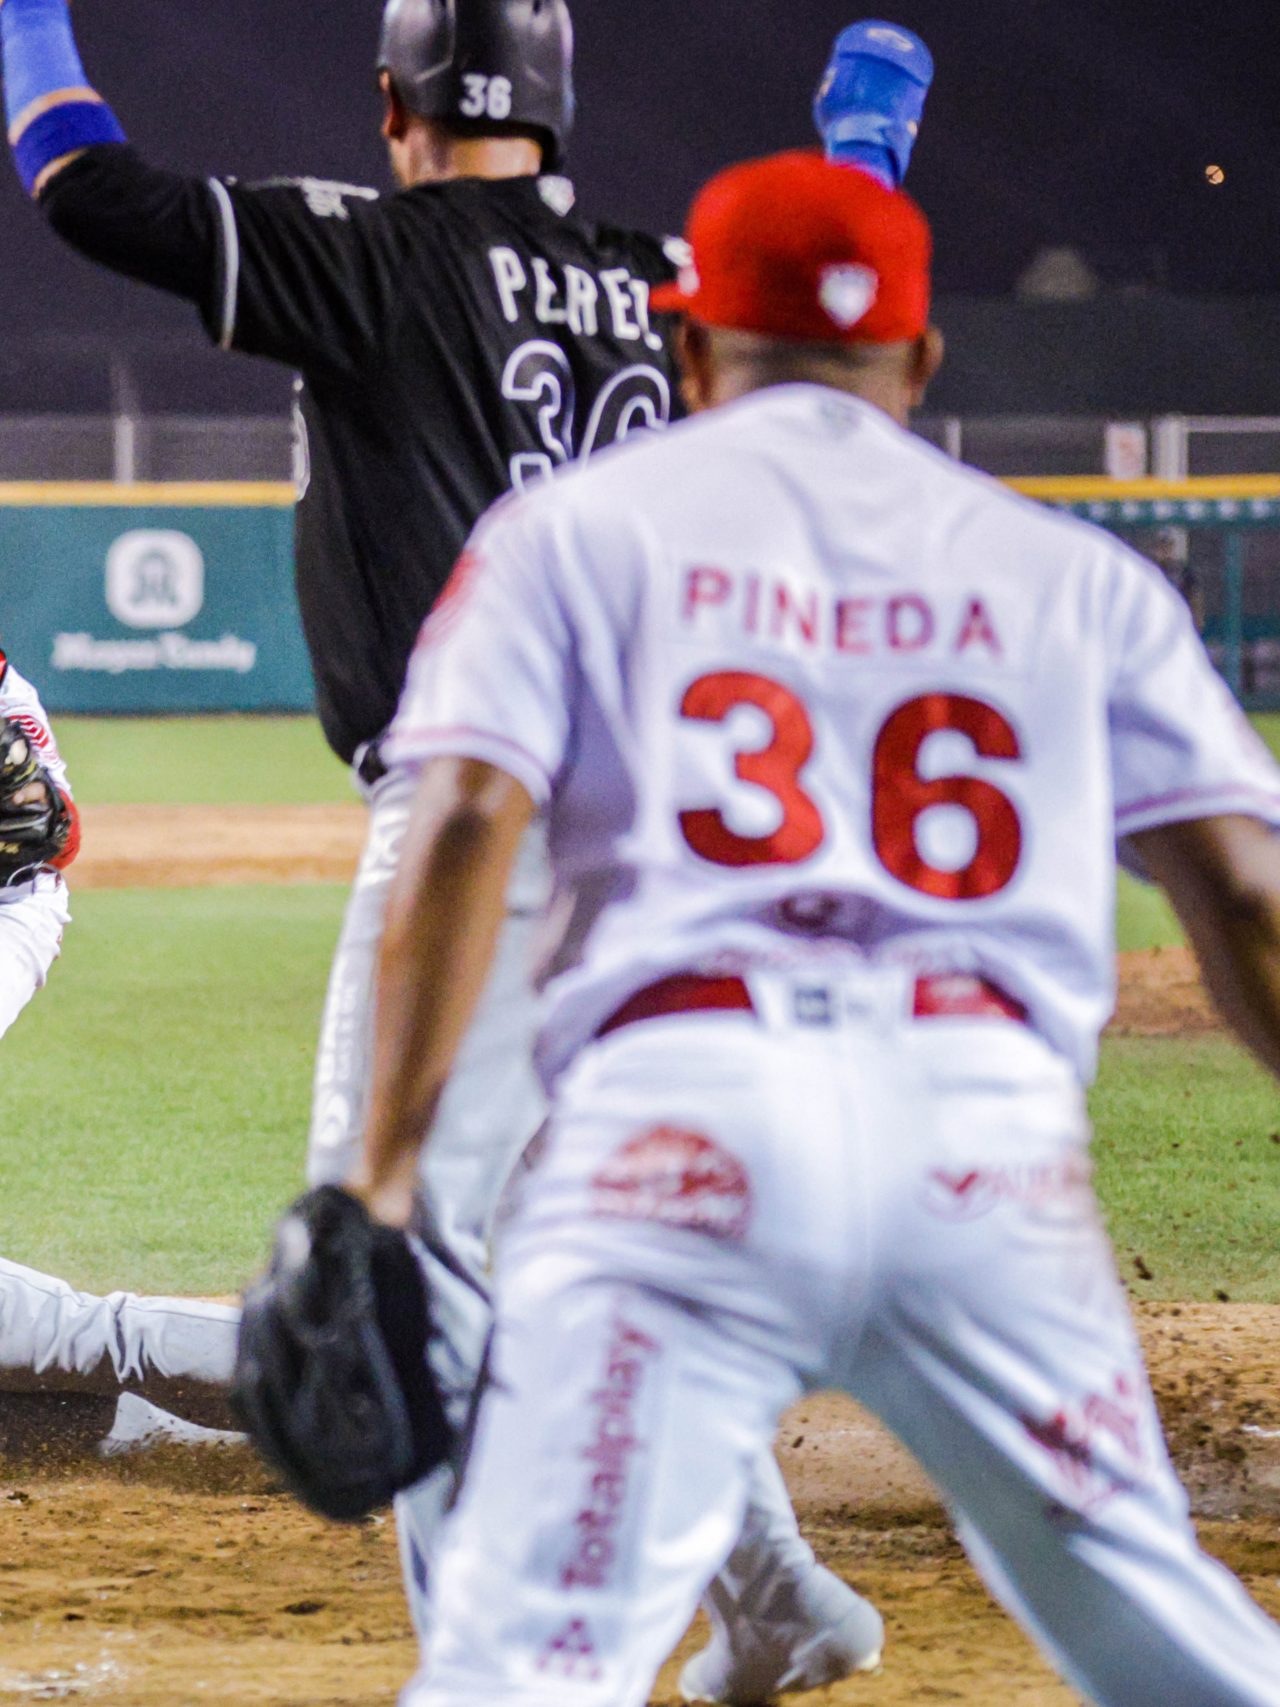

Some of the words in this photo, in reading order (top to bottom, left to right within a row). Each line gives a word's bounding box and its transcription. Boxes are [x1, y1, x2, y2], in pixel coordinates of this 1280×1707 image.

[460, 73, 512, 120] 36
[682, 565, 1003, 658] PINEDA
[679, 669, 1023, 900] 36
